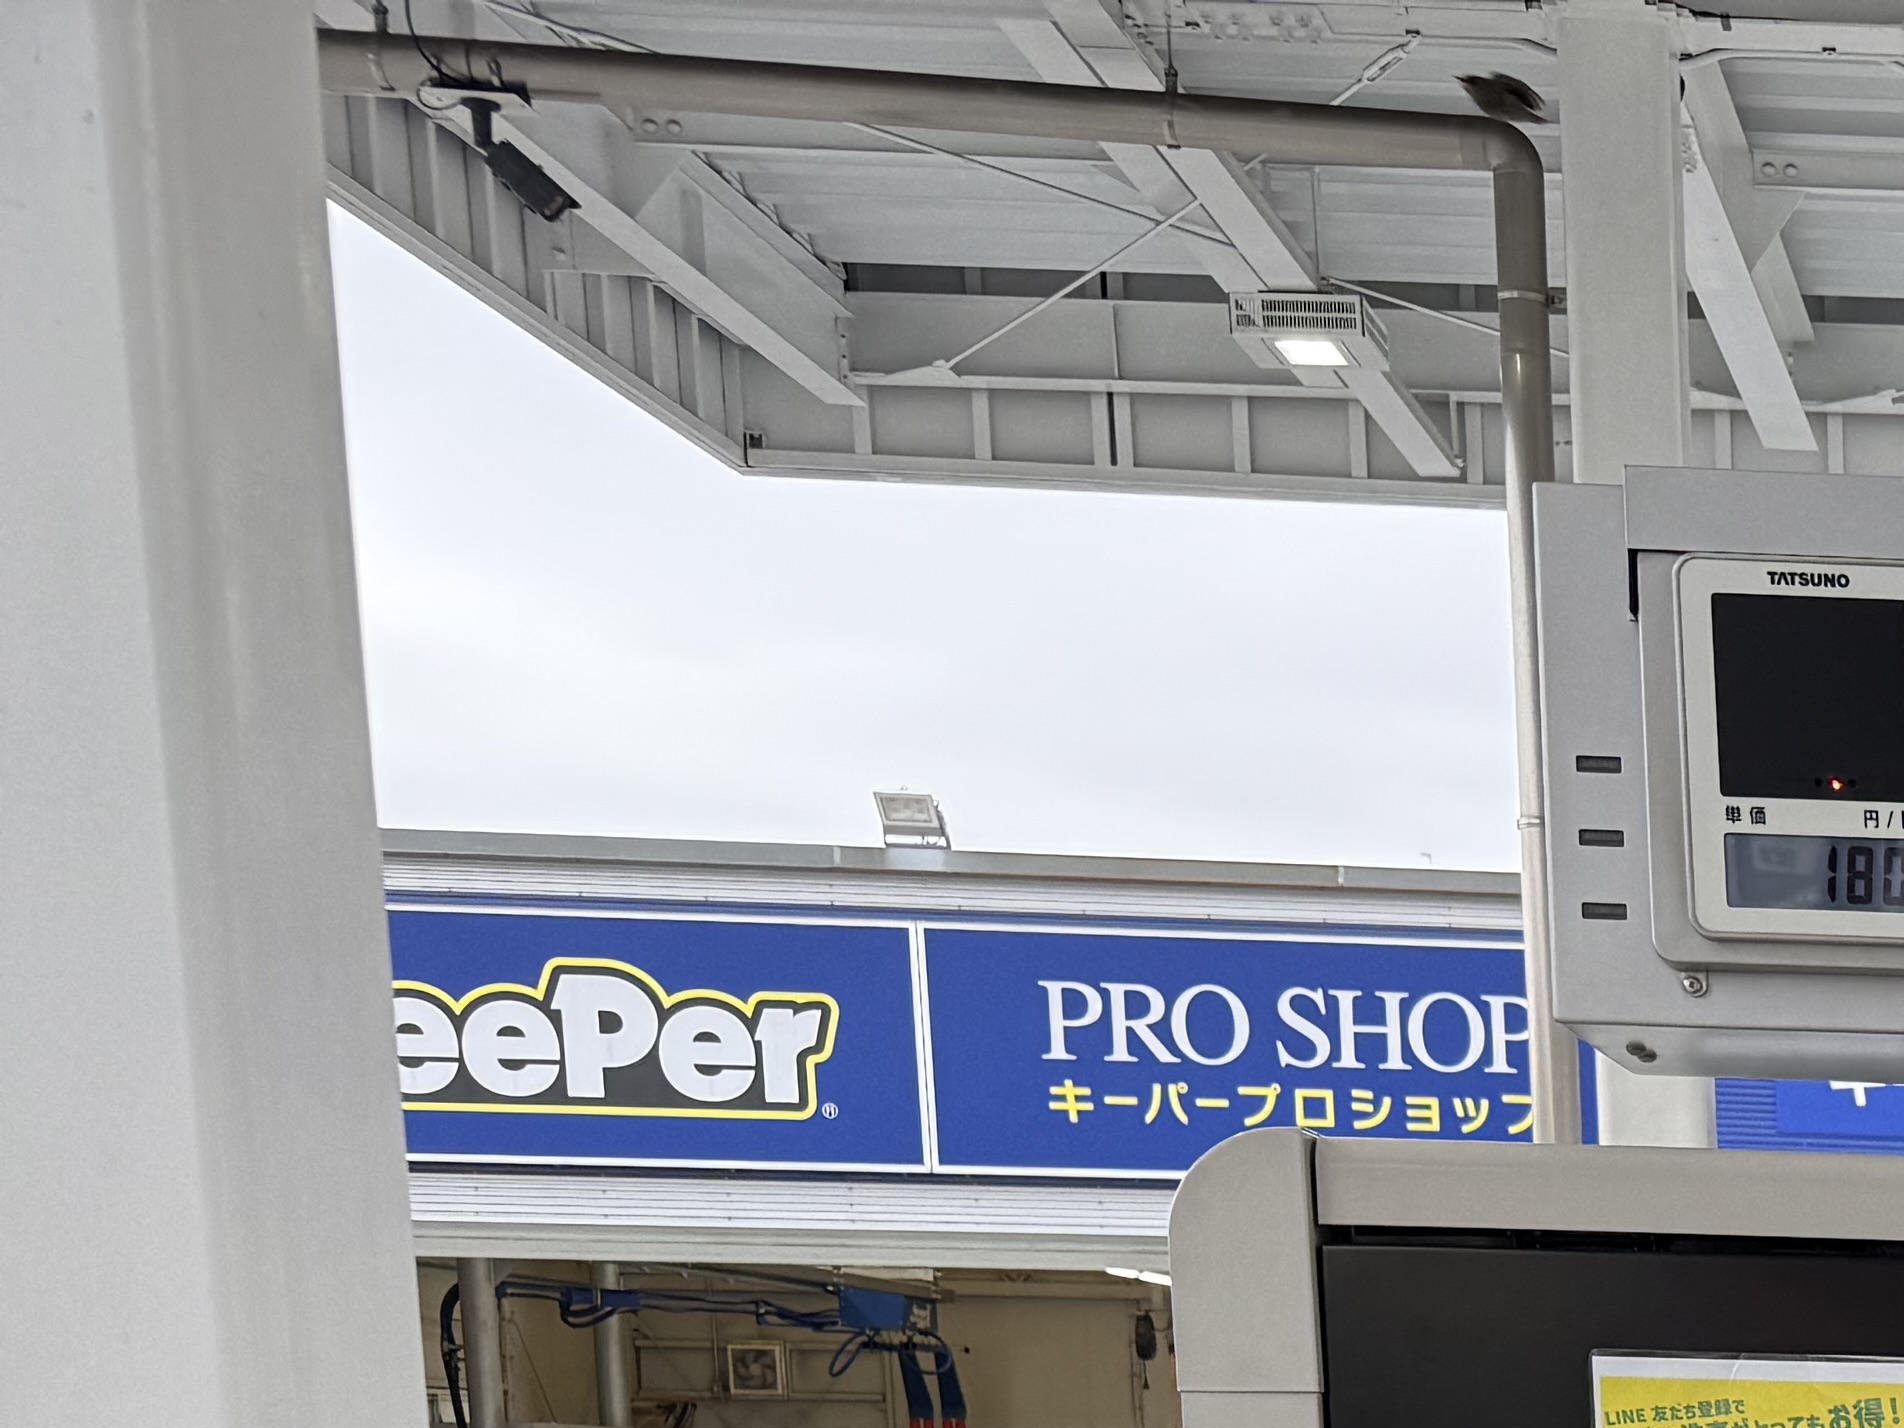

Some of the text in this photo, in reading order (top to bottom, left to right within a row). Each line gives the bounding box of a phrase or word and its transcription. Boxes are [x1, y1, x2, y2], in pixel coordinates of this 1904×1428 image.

[1767, 571, 1850, 588] TATSUNO
[1726, 806, 1766, 825] 単価
[1038, 980, 1530, 1074] PRO SHOP
[1605, 1398, 1745, 1426] LINE 友だち登録で
